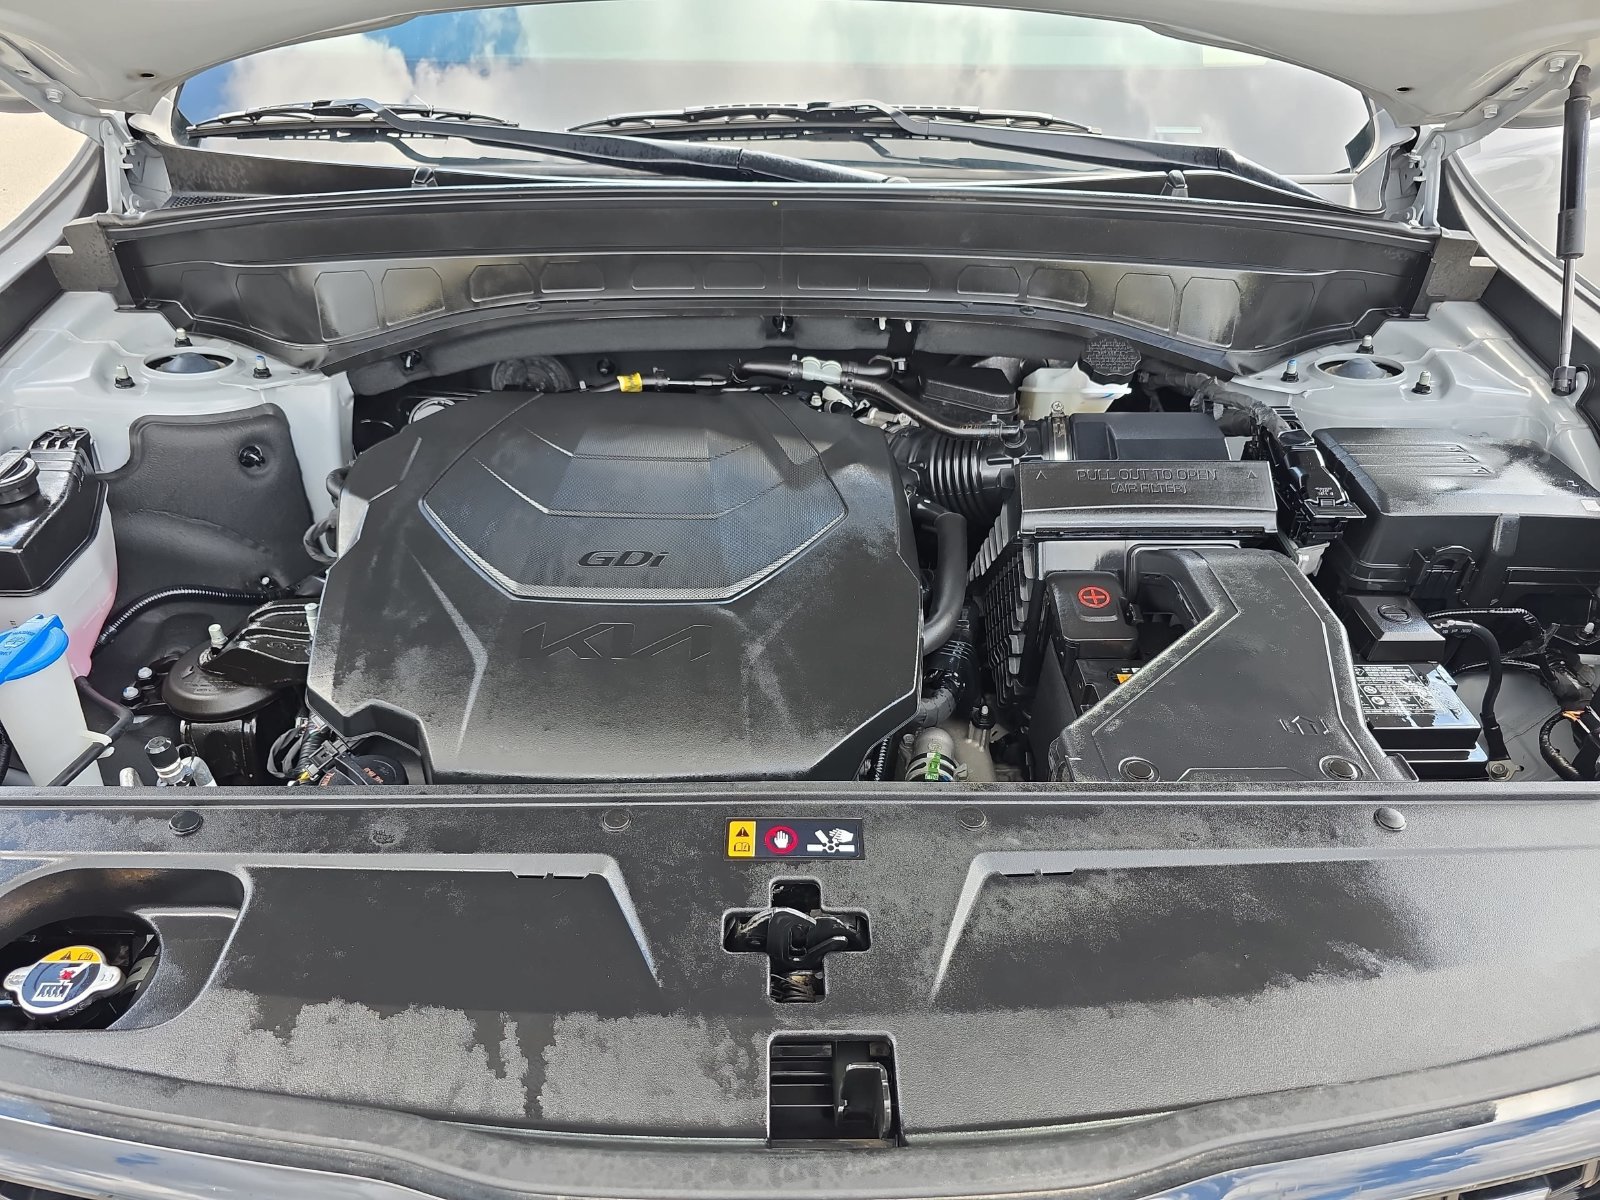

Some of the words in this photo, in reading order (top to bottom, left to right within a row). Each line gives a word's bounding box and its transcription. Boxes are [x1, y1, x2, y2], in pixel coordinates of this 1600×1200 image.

[1076, 468, 1116, 481] PULL
[1118, 468, 1150, 481] OUT
[1152, 468, 1173, 481] TO
[1176, 468, 1218, 481] OPEN
[577, 550, 669, 568] GDi
